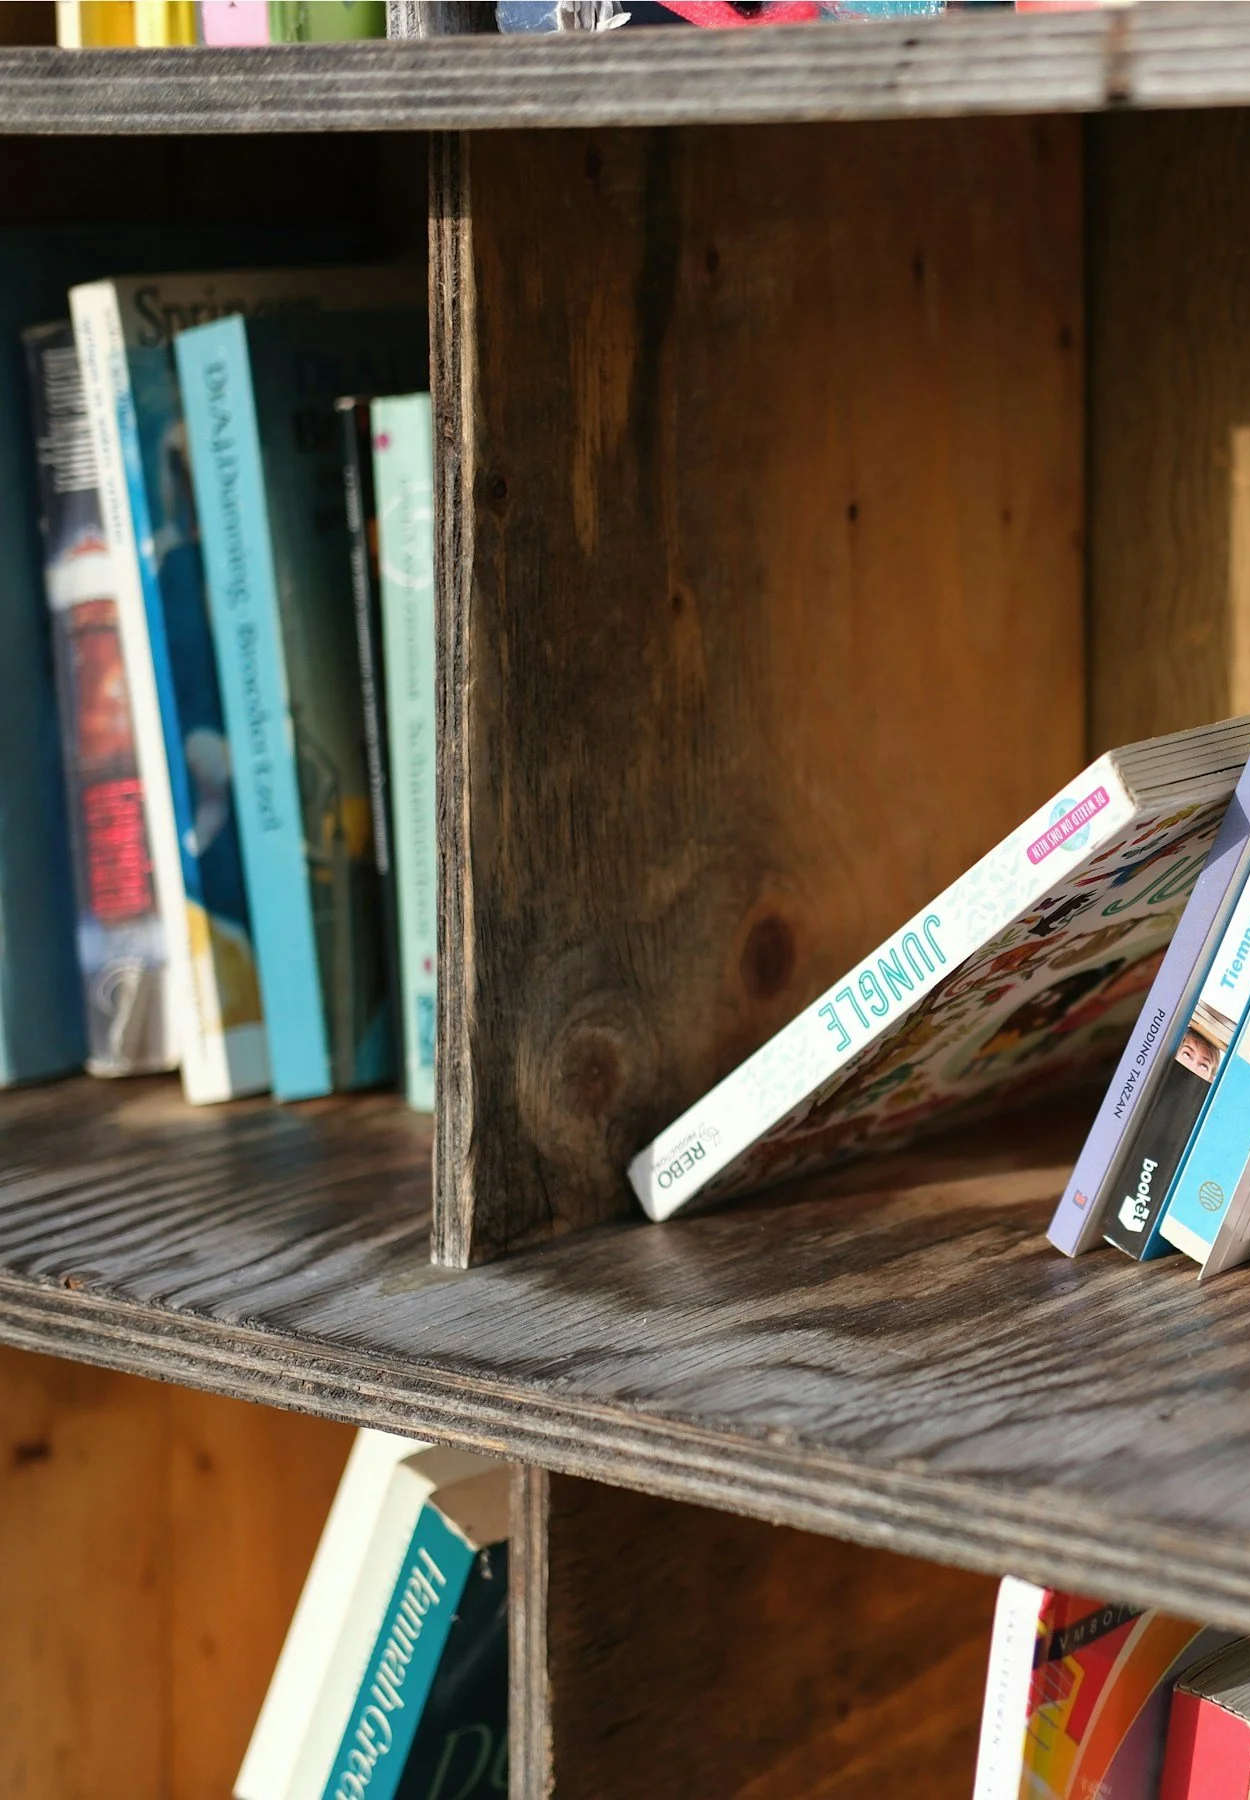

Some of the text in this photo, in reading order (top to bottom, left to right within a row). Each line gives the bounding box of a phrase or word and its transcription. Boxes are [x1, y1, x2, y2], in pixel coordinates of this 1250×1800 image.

[1031, 792, 1106, 859] DE WERELD OM ONS HEEN
[1100, 851, 1209, 917] JU
[817, 914, 948, 1053] JUNGLE
[1114, 1009, 1165, 1119] PUDDING TARZAN
[656, 1141, 707, 1190] REBO
[1134, 1158, 1160, 1225] booket
[369, 1546, 447, 1712] Hannah
